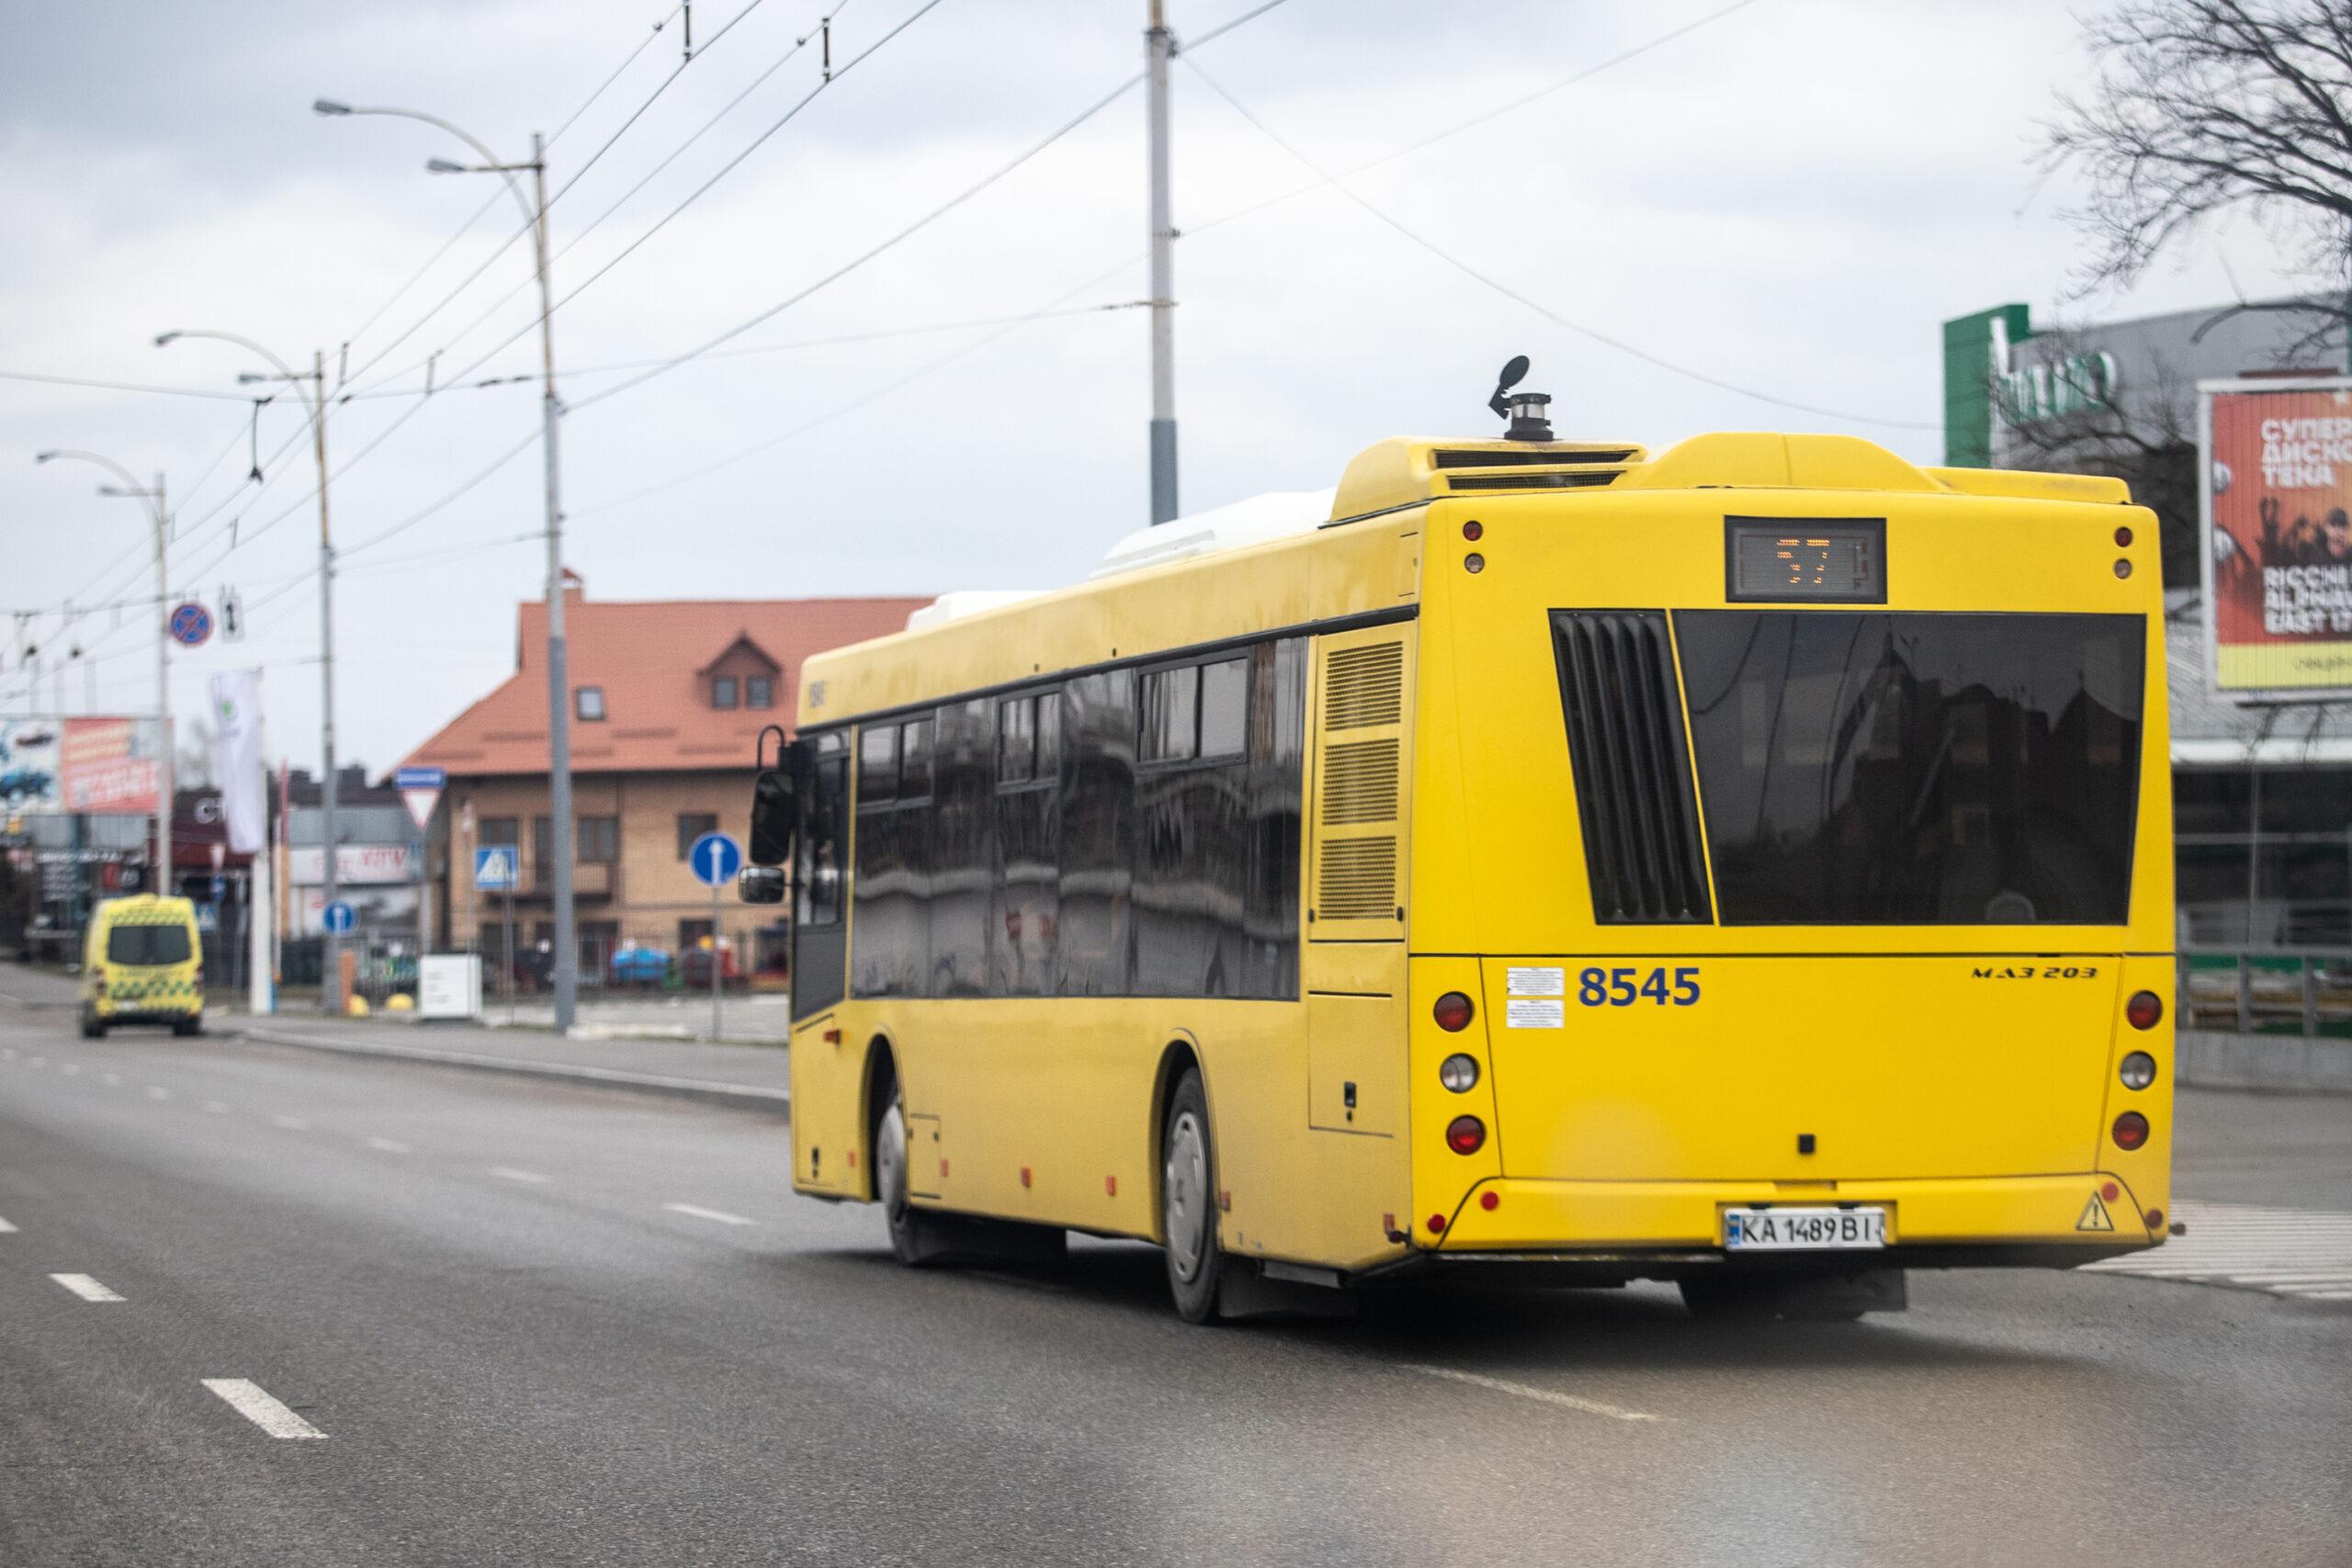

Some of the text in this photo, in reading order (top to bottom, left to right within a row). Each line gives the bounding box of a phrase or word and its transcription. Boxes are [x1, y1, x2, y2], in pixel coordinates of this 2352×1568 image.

[1776, 538, 1831, 585] 57
[1578, 966, 1701, 1007] 8545
[2042, 966, 2098, 979] 203
